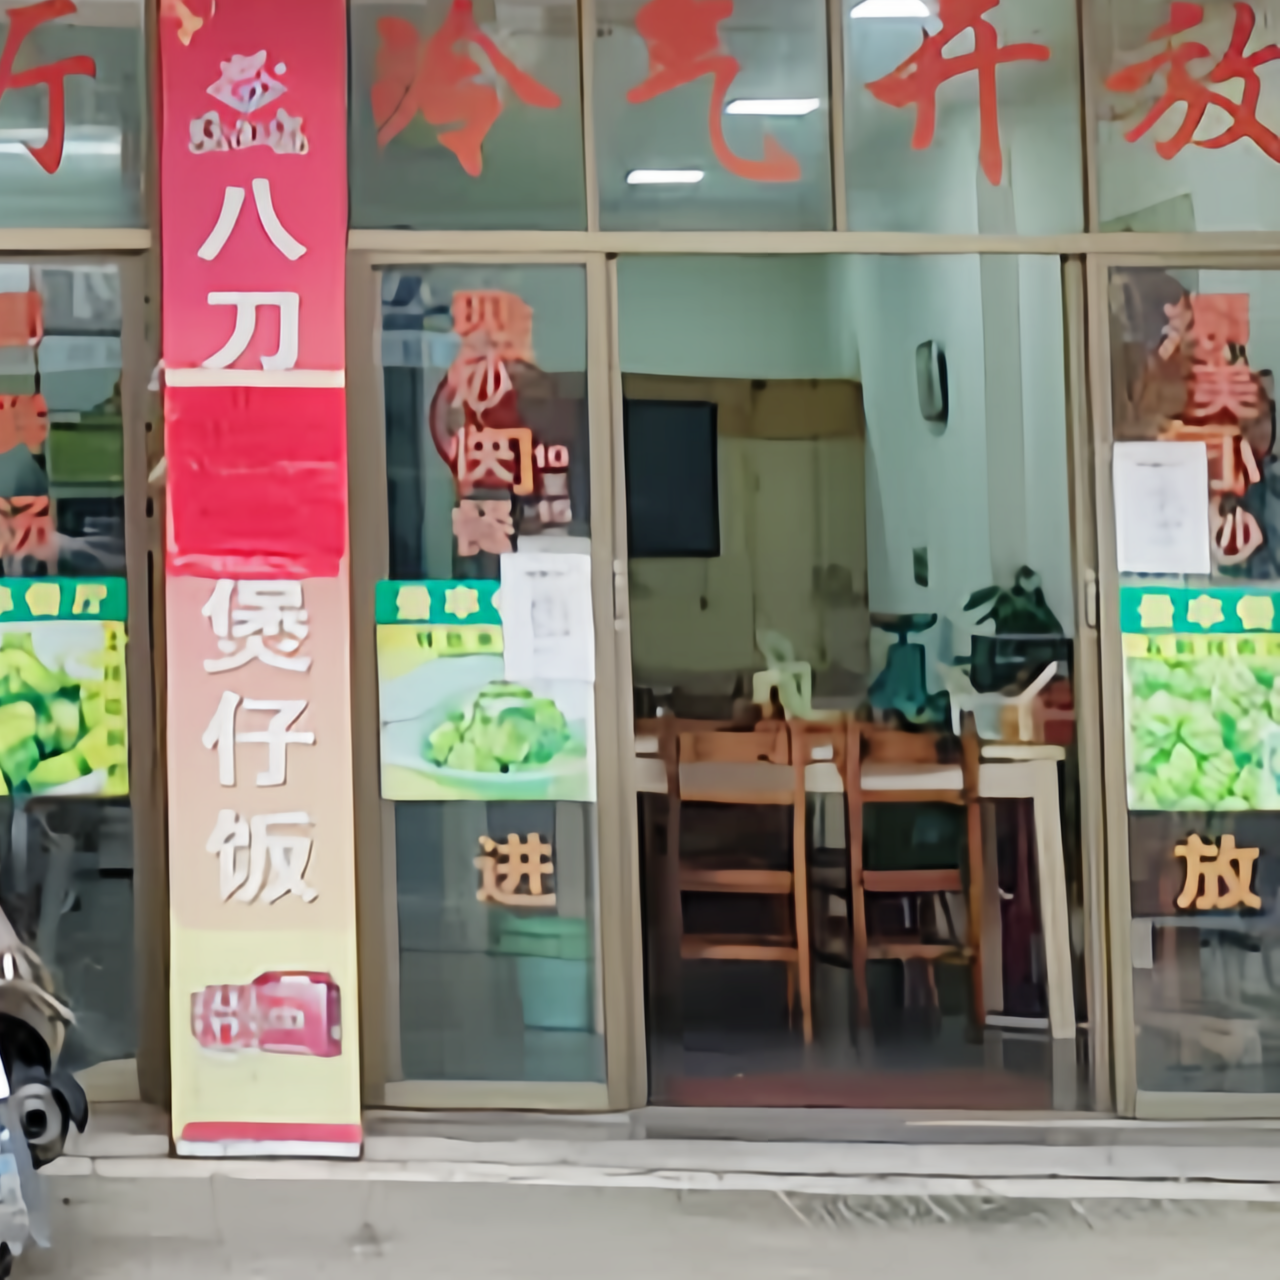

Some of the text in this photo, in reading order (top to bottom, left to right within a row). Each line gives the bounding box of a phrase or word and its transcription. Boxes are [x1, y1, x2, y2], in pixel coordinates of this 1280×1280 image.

[196, 177, 308, 371] 八刀
[200, 577, 320, 906] 煲仔饭
[475, 831, 558, 908] 进
[1174, 833, 1262, 911] 放
